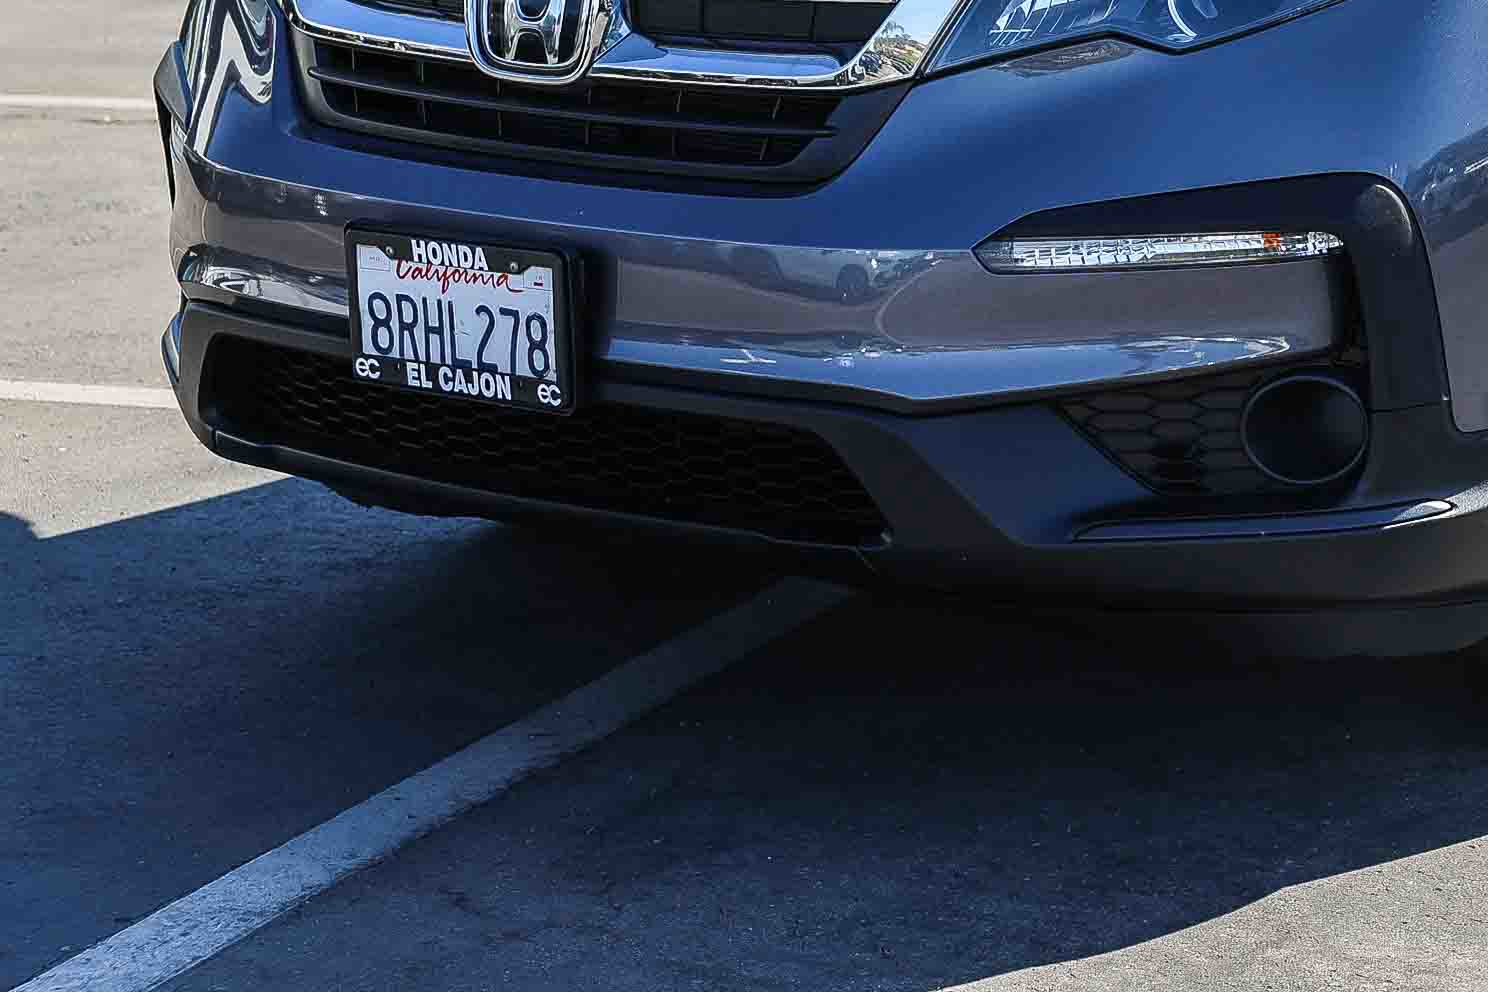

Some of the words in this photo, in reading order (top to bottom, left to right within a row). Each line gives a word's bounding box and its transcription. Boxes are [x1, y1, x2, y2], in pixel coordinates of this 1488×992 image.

[410, 239, 489, 271] HONDA
[395, 257, 524, 295] California
[367, 291, 550, 379] 8RHL278
[405, 361, 433, 389] EL
[438, 366, 512, 401] CAJON
